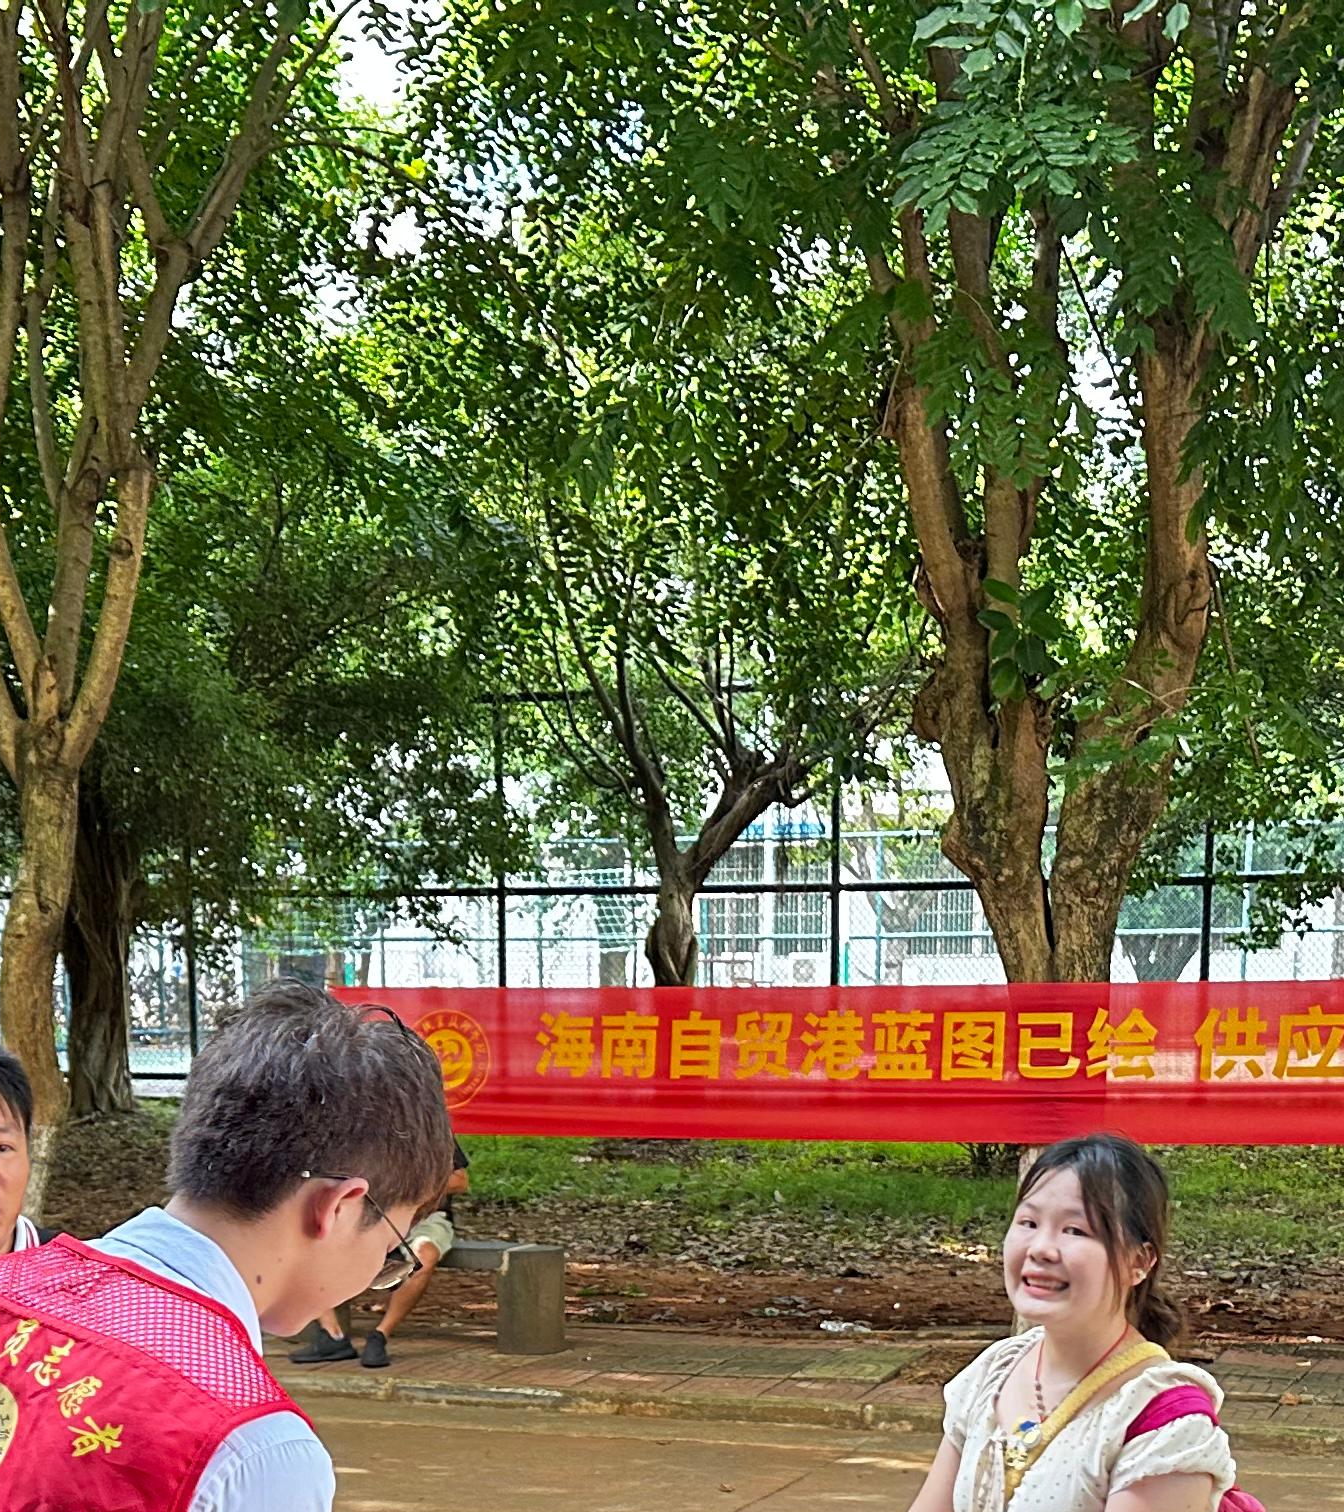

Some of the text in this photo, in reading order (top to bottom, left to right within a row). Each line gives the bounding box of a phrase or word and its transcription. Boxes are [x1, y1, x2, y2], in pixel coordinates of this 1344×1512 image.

[535, 1007, 1159, 1082] 海南自贸港蓝图已绘
